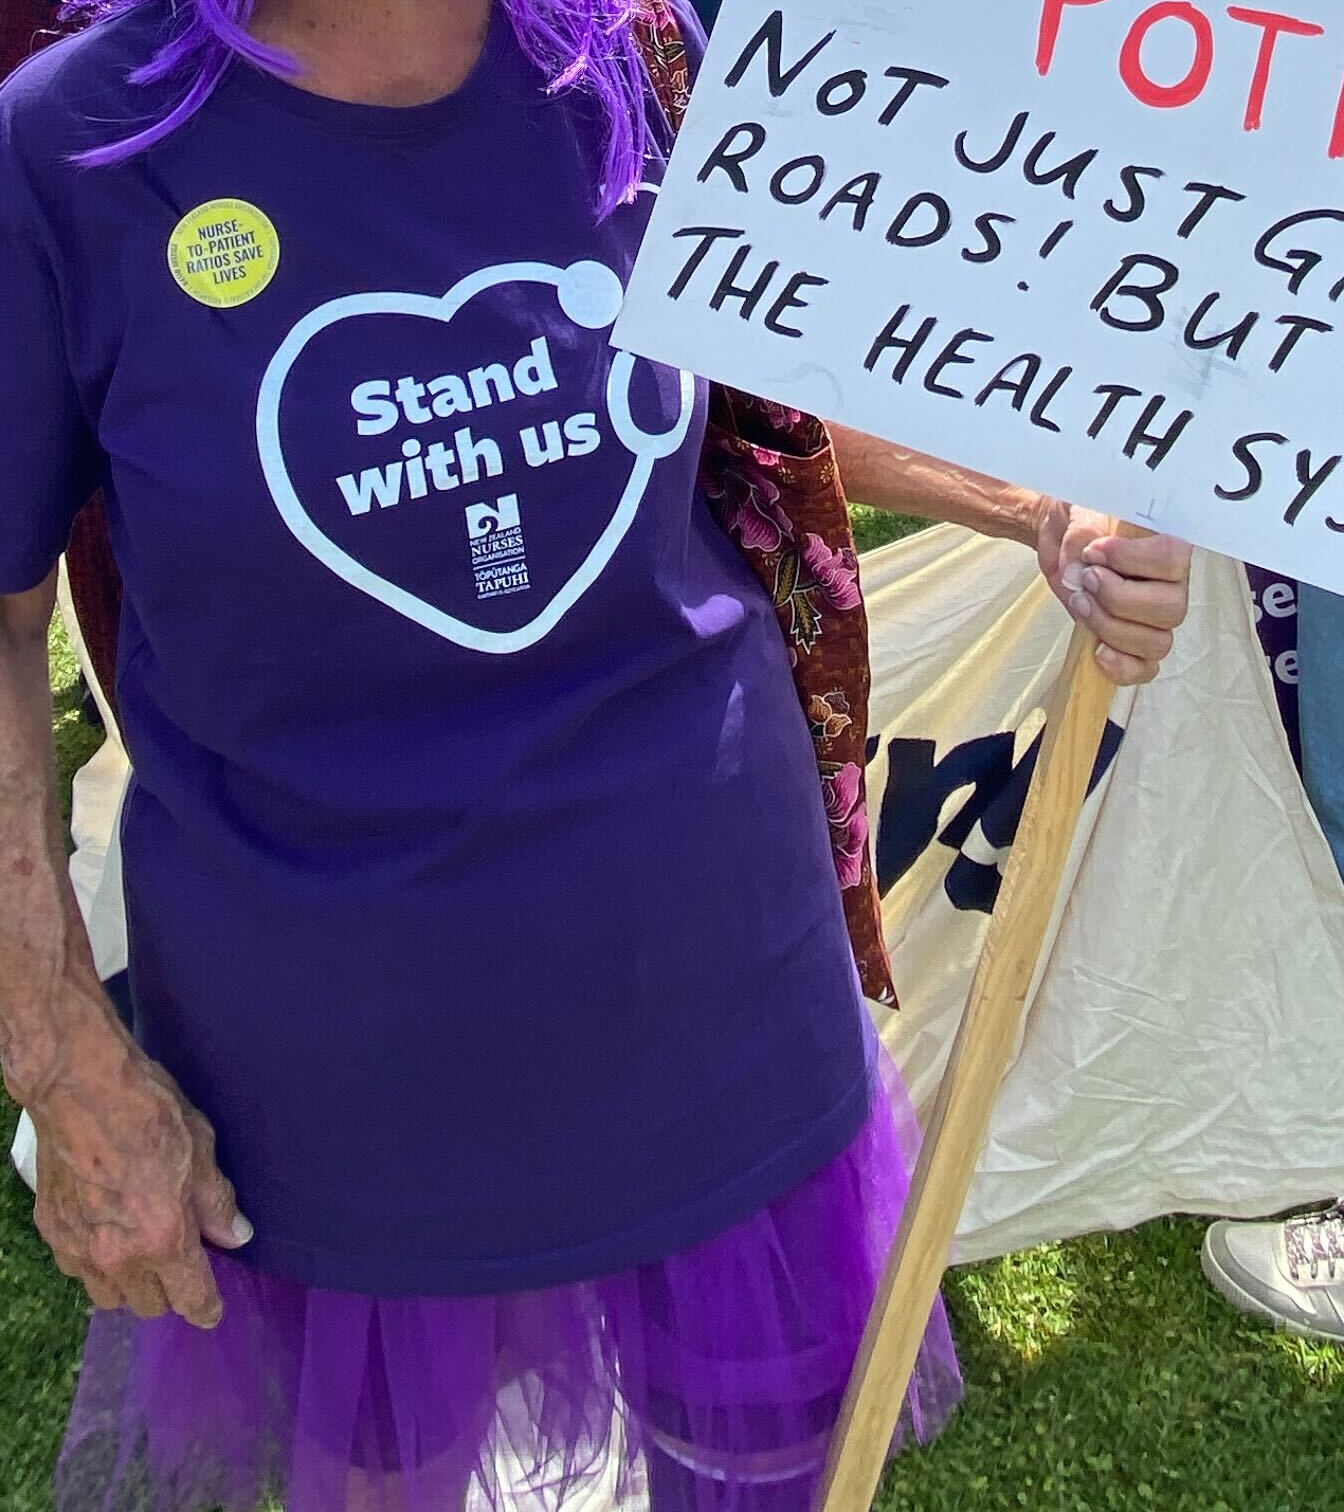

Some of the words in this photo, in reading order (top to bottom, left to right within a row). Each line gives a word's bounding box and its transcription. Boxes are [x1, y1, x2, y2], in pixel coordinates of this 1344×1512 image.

[723, 9, 951, 128] NOT
[954, 111, 1248, 239] JUST
[186, 230, 256, 258] TO-PATIENT
[197, 219, 244, 240] NURSE-
[186, 253, 232, 274] RATIOS
[233, 244, 264, 264] SAVE
[696, 122, 1075, 292] ROADS!
[1089, 253, 1334, 375] BUT
[213, 265, 248, 286] LIVES
[666, 226, 830, 338] THE
[863, 304, 1195, 472] HEALTH
[350, 335, 558, 436] Stand
[335, 426, 504, 517] with
[519, 412, 602, 468] us
[471, 534, 524, 558] NURSES
[475, 571, 529, 594] TAPUHI
